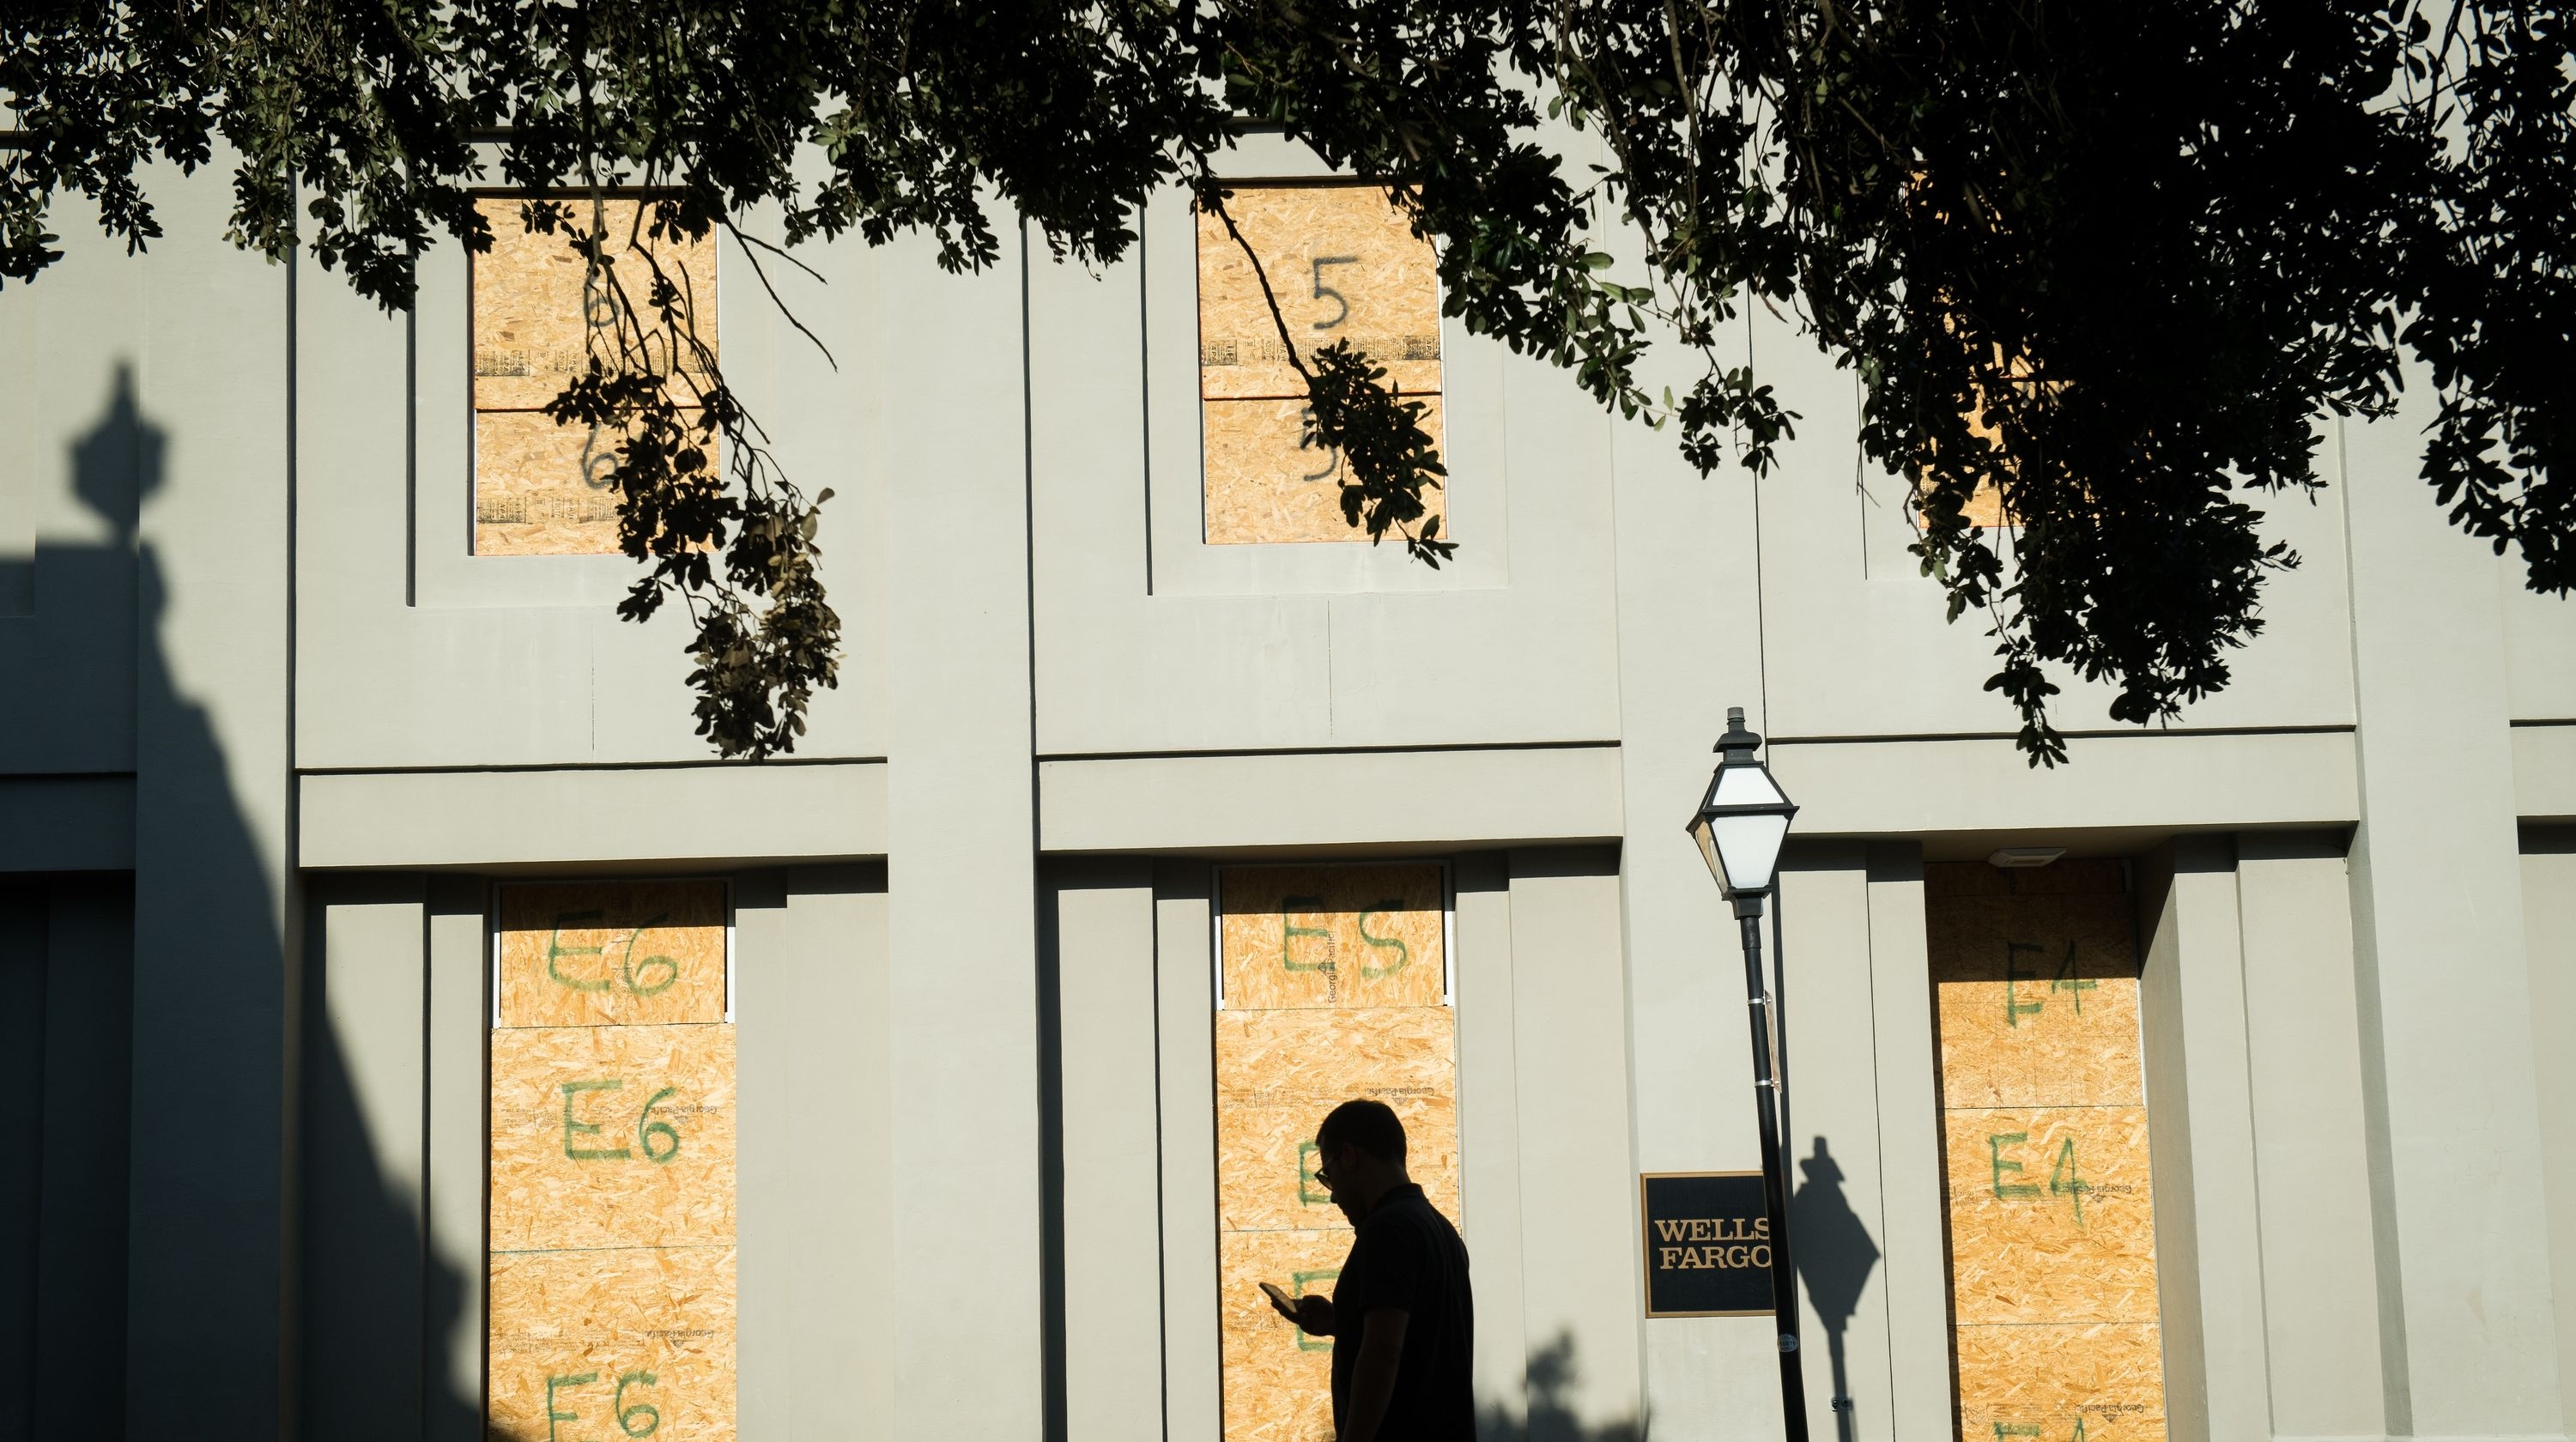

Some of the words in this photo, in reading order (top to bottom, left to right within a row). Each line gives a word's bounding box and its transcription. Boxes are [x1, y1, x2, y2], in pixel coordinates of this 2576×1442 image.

[1312, 255, 1359, 330] 5
[582, 421, 620, 490] 6
[1654, 1217, 1771, 1242] WELLS
[1658, 1245, 1773, 1269] FARGO
